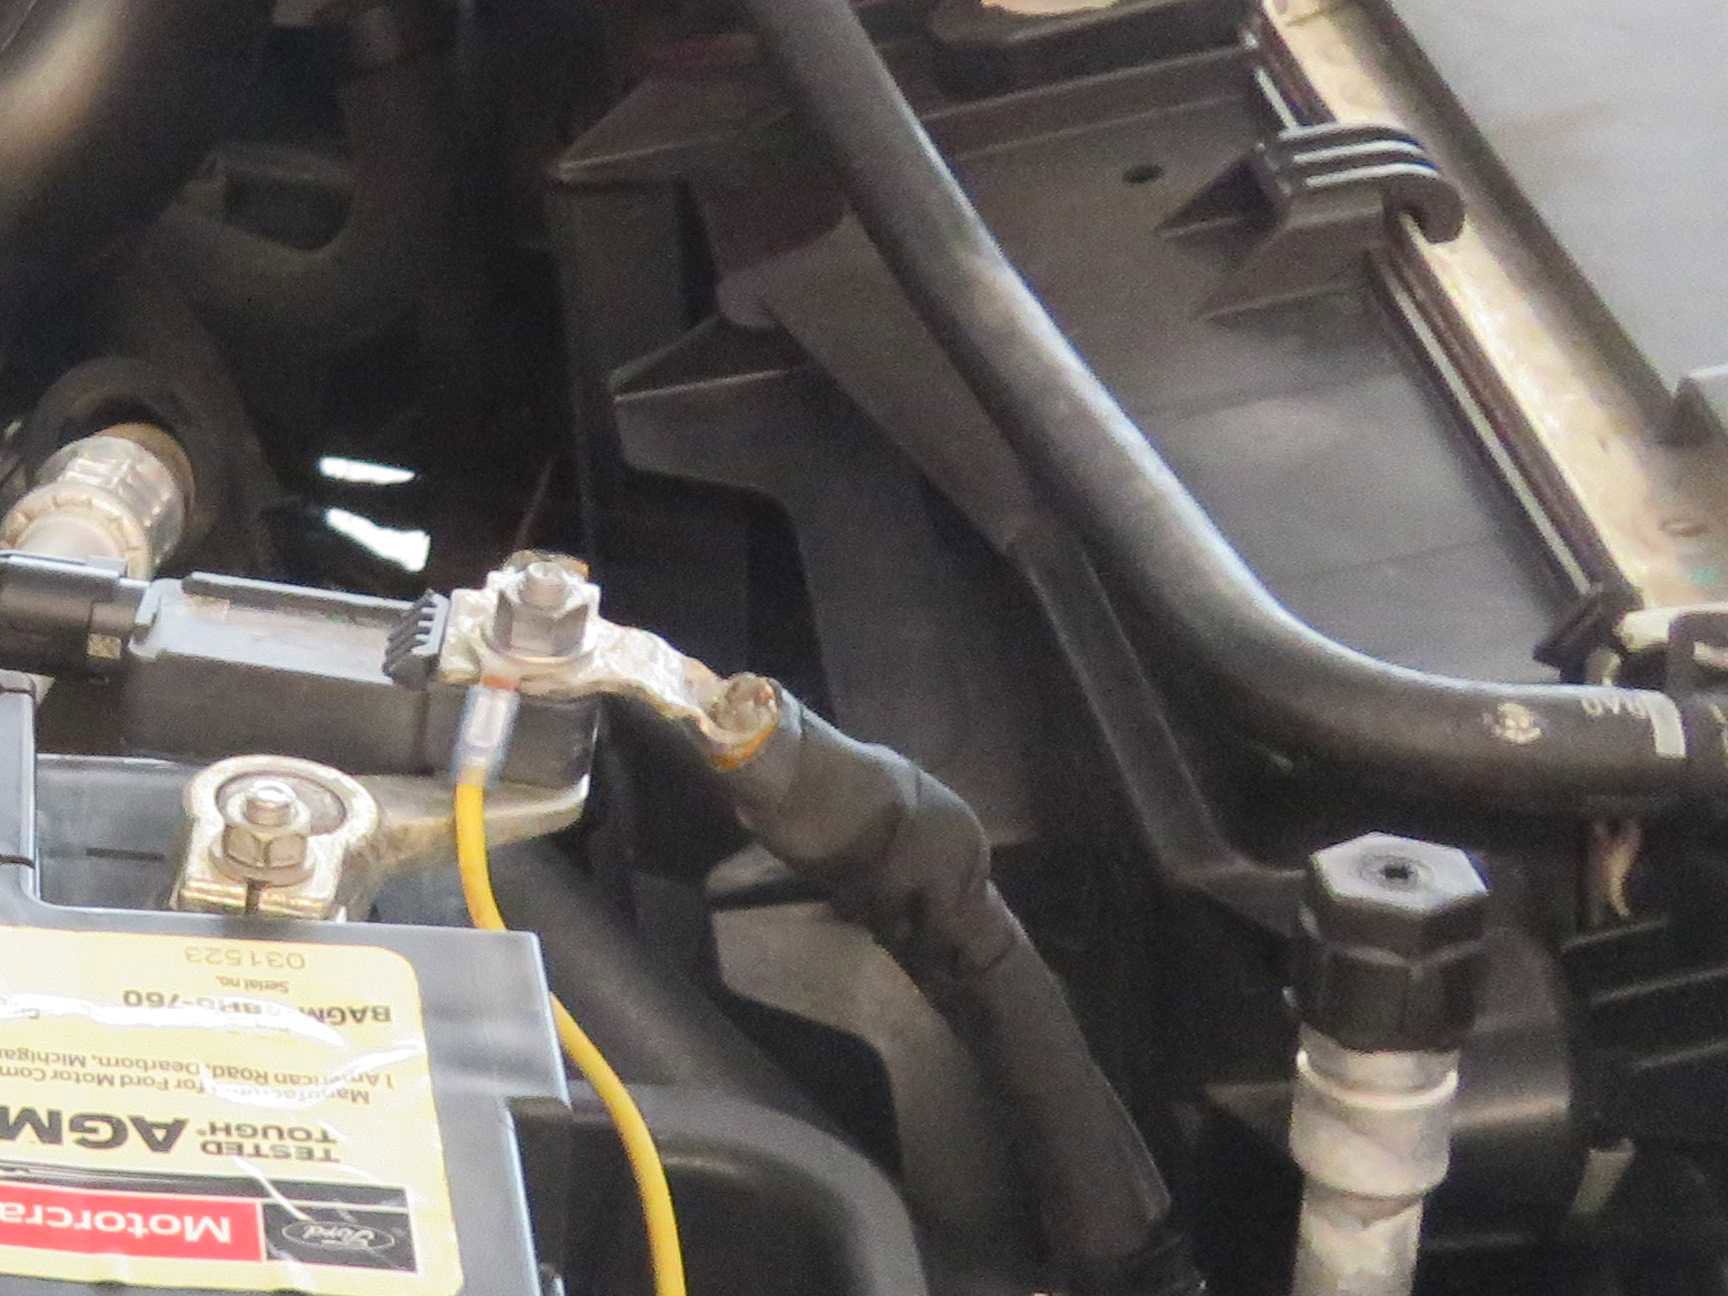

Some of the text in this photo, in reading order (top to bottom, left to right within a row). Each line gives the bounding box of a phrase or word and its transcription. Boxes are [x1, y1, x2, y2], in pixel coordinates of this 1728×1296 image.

[183, 946, 305, 969] 031523
[215, 976, 288, 993] Serial no.
[91, 1054, 200, 1077] Dearborn,
[205, 1064, 269, 1085] Road,
[51, 1070, 115, 1087] Motor
[119, 1074, 169, 1091] Ford
[178, 1079, 204, 1094] for
[199, 1140, 340, 1164] TESTED
[300, 1221, 376, 1248] Ford
